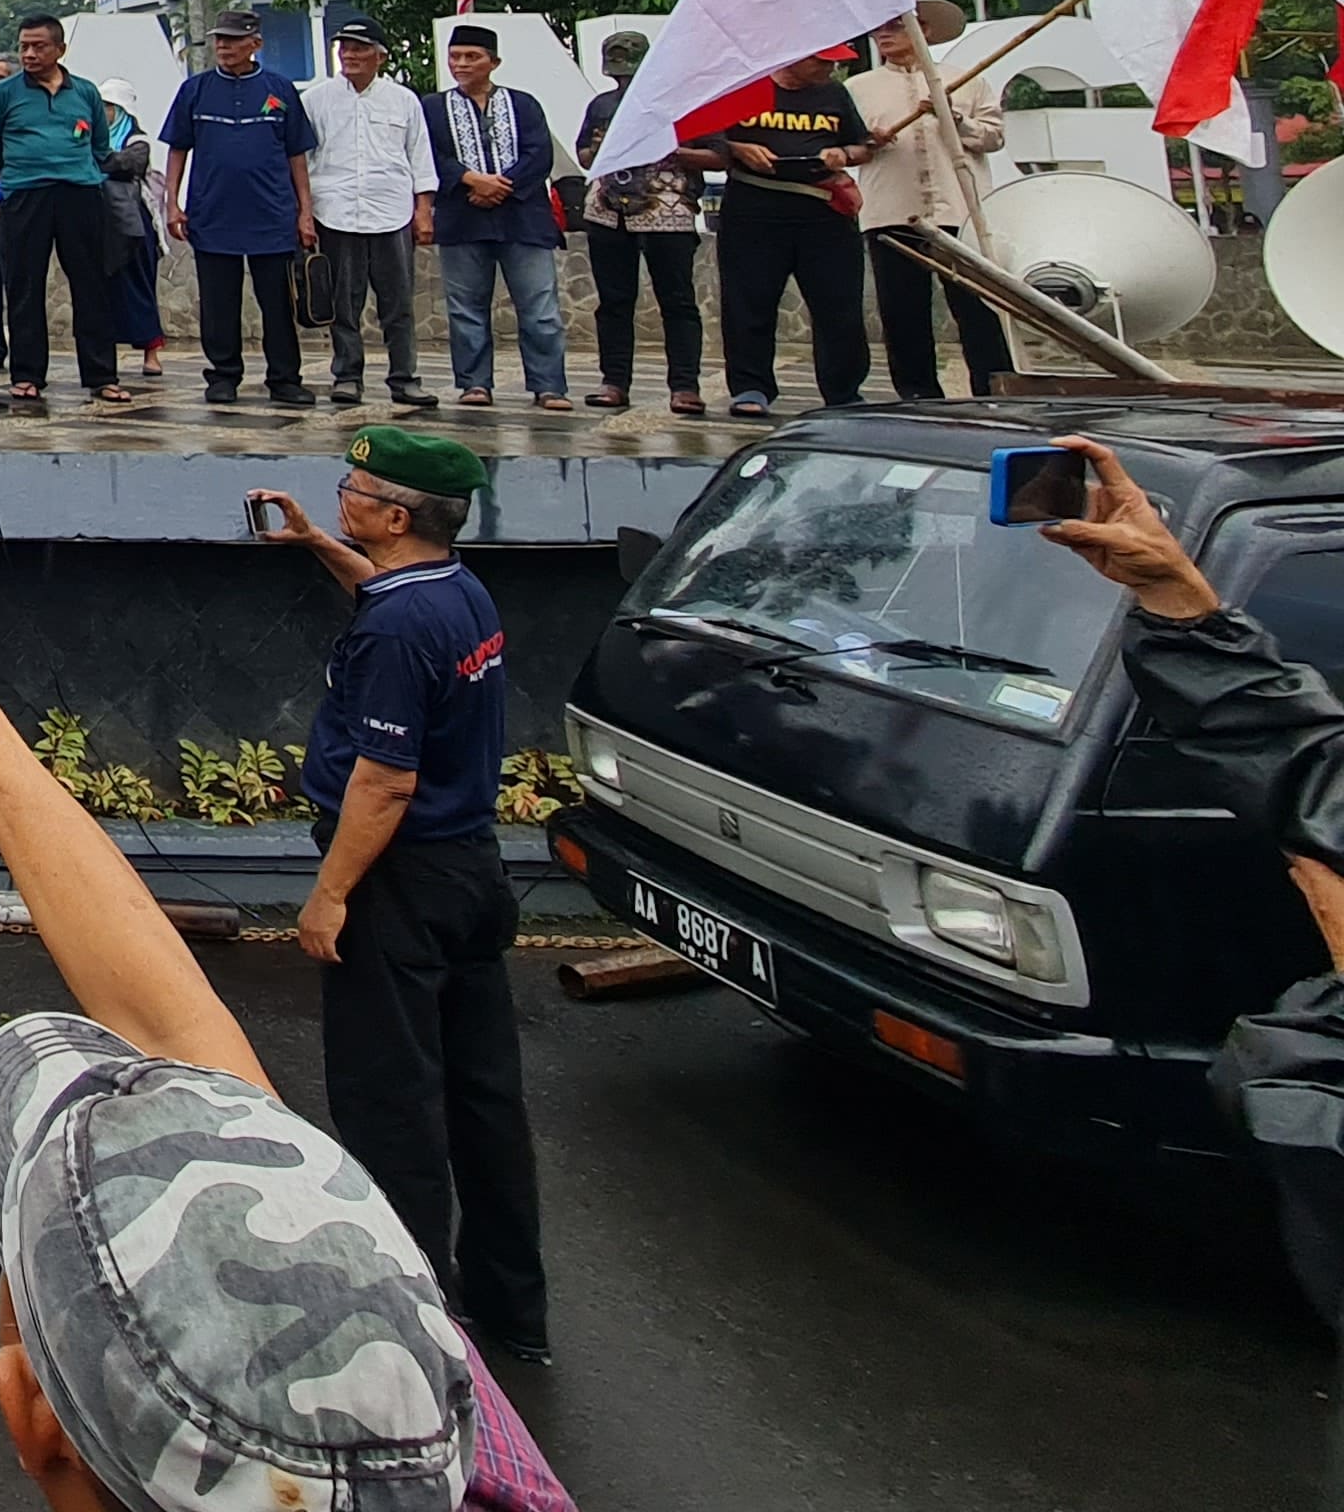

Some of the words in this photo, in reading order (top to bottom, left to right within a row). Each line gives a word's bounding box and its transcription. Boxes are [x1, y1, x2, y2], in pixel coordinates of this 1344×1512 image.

[634, 881, 660, 926] AA
[676, 903, 731, 962] 8687
[751, 940, 768, 983] A
